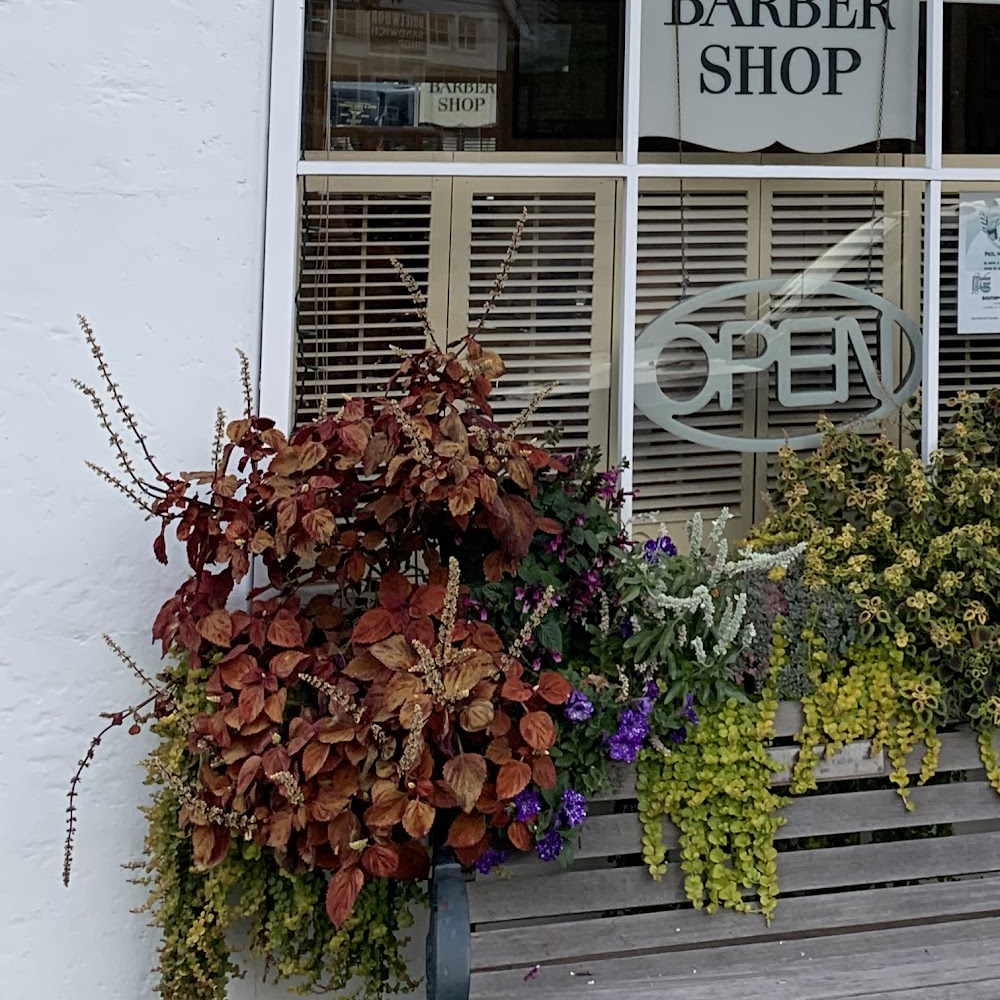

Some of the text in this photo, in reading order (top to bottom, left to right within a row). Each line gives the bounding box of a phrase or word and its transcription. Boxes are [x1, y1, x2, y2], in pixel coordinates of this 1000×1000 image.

[699, 44, 862, 96] SHOP
[429, 82, 495, 94] BARBER
[438, 97, 486, 112] SHOP
[641, 314, 894, 414] OPEN
